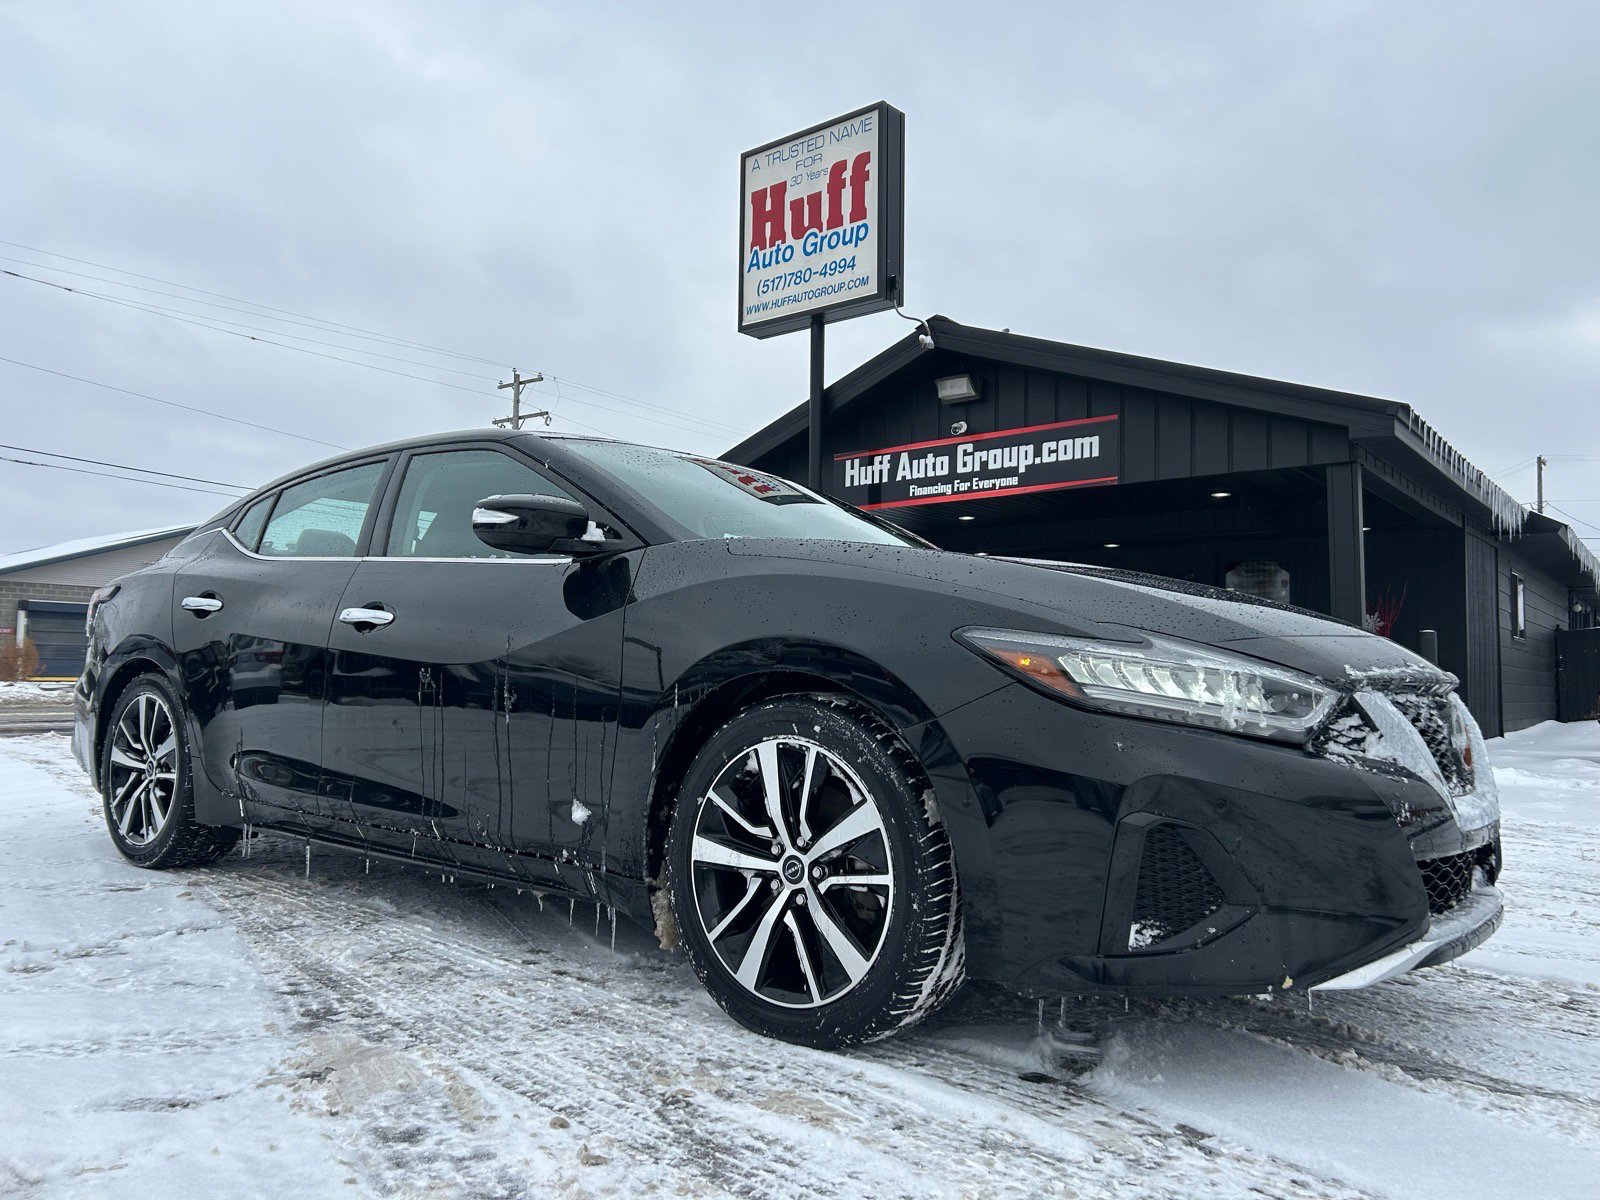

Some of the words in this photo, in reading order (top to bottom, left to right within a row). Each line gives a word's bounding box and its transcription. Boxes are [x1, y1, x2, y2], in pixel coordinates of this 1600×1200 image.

[751, 158, 761, 173] A
[765, 134, 825, 167] TRUSTED
[829, 116, 873, 145] NAME
[795, 153, 823, 172] FOR
[790, 173, 803, 187] 30
[806, 167, 830, 181] Years
[750, 151, 871, 252] Huff
[747, 243, 795, 274] Auto
[802, 222, 869, 257] Group
[746, 276, 870, 316] WWW.HUFFAUTOGROUP.COM
[757, 255, 857, 297] (517)780-4994
[844, 453, 891, 488] Huff
[896, 452, 950, 482] Auto
[956, 435, 1100, 474] Group.com
[909, 482, 952, 497] Financing
[954, 479, 971, 492] For
[972, 476, 1019, 490] Everyone
